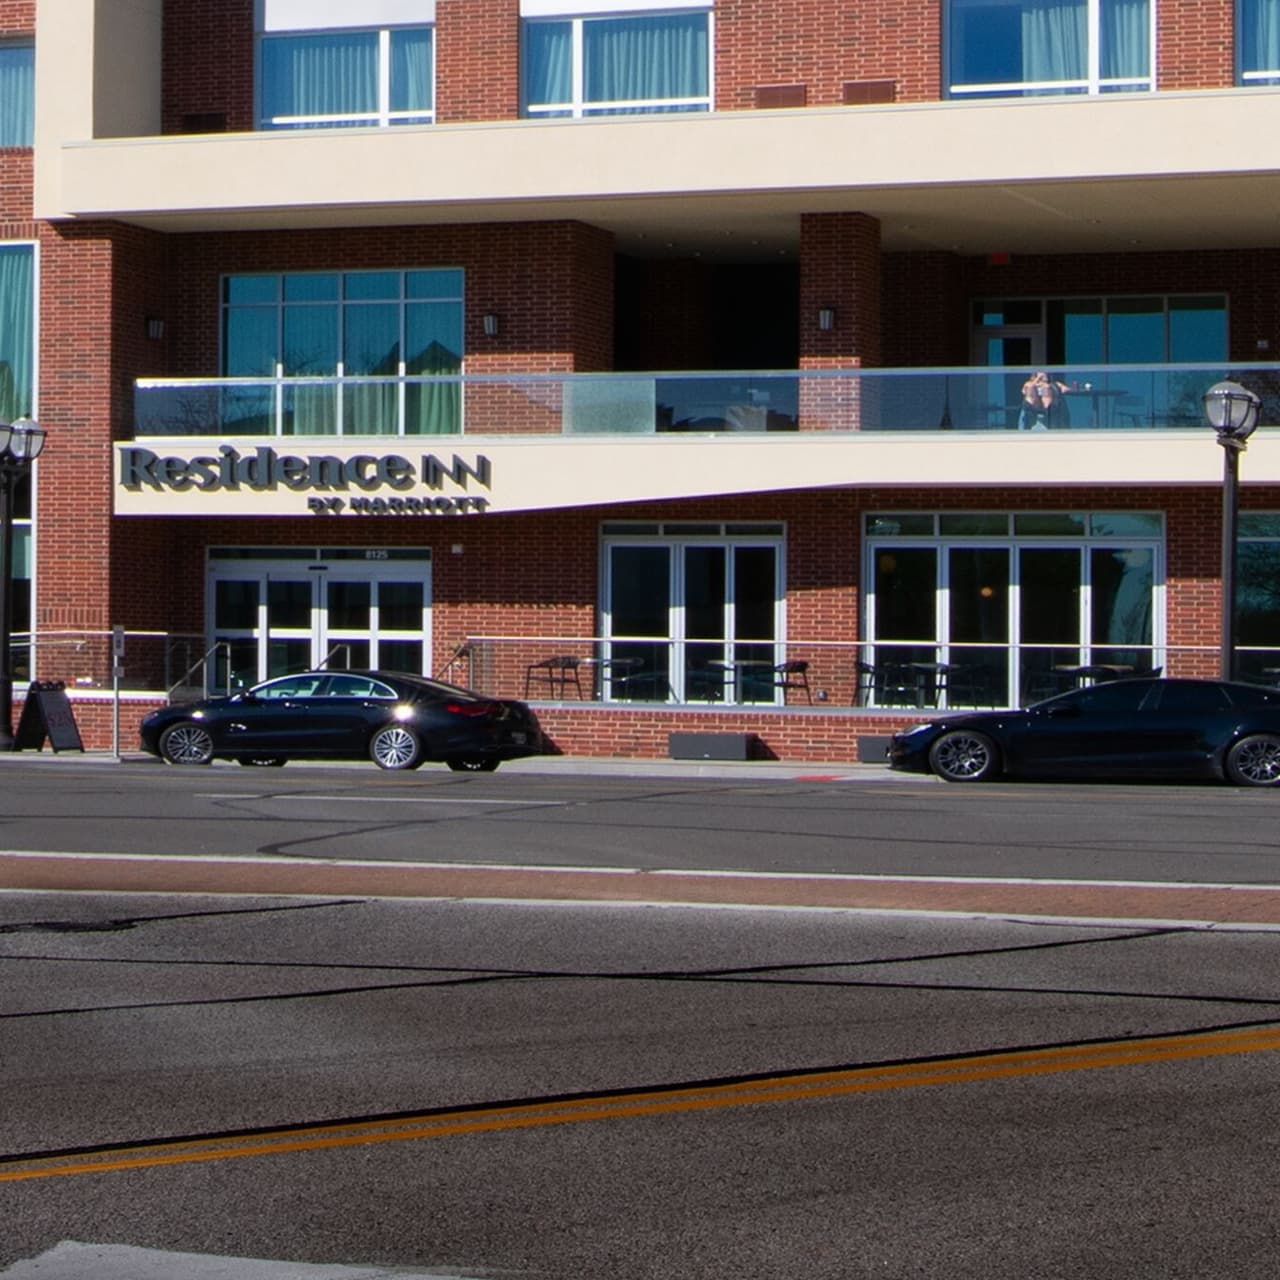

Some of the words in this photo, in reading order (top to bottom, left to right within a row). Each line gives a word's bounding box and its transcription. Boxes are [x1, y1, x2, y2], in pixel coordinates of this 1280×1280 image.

[119, 445, 416, 491] Residence
[421, 454, 491, 490] INN
[307, 497, 346, 514] BY
[350, 497, 490, 514] MARRIOTT
